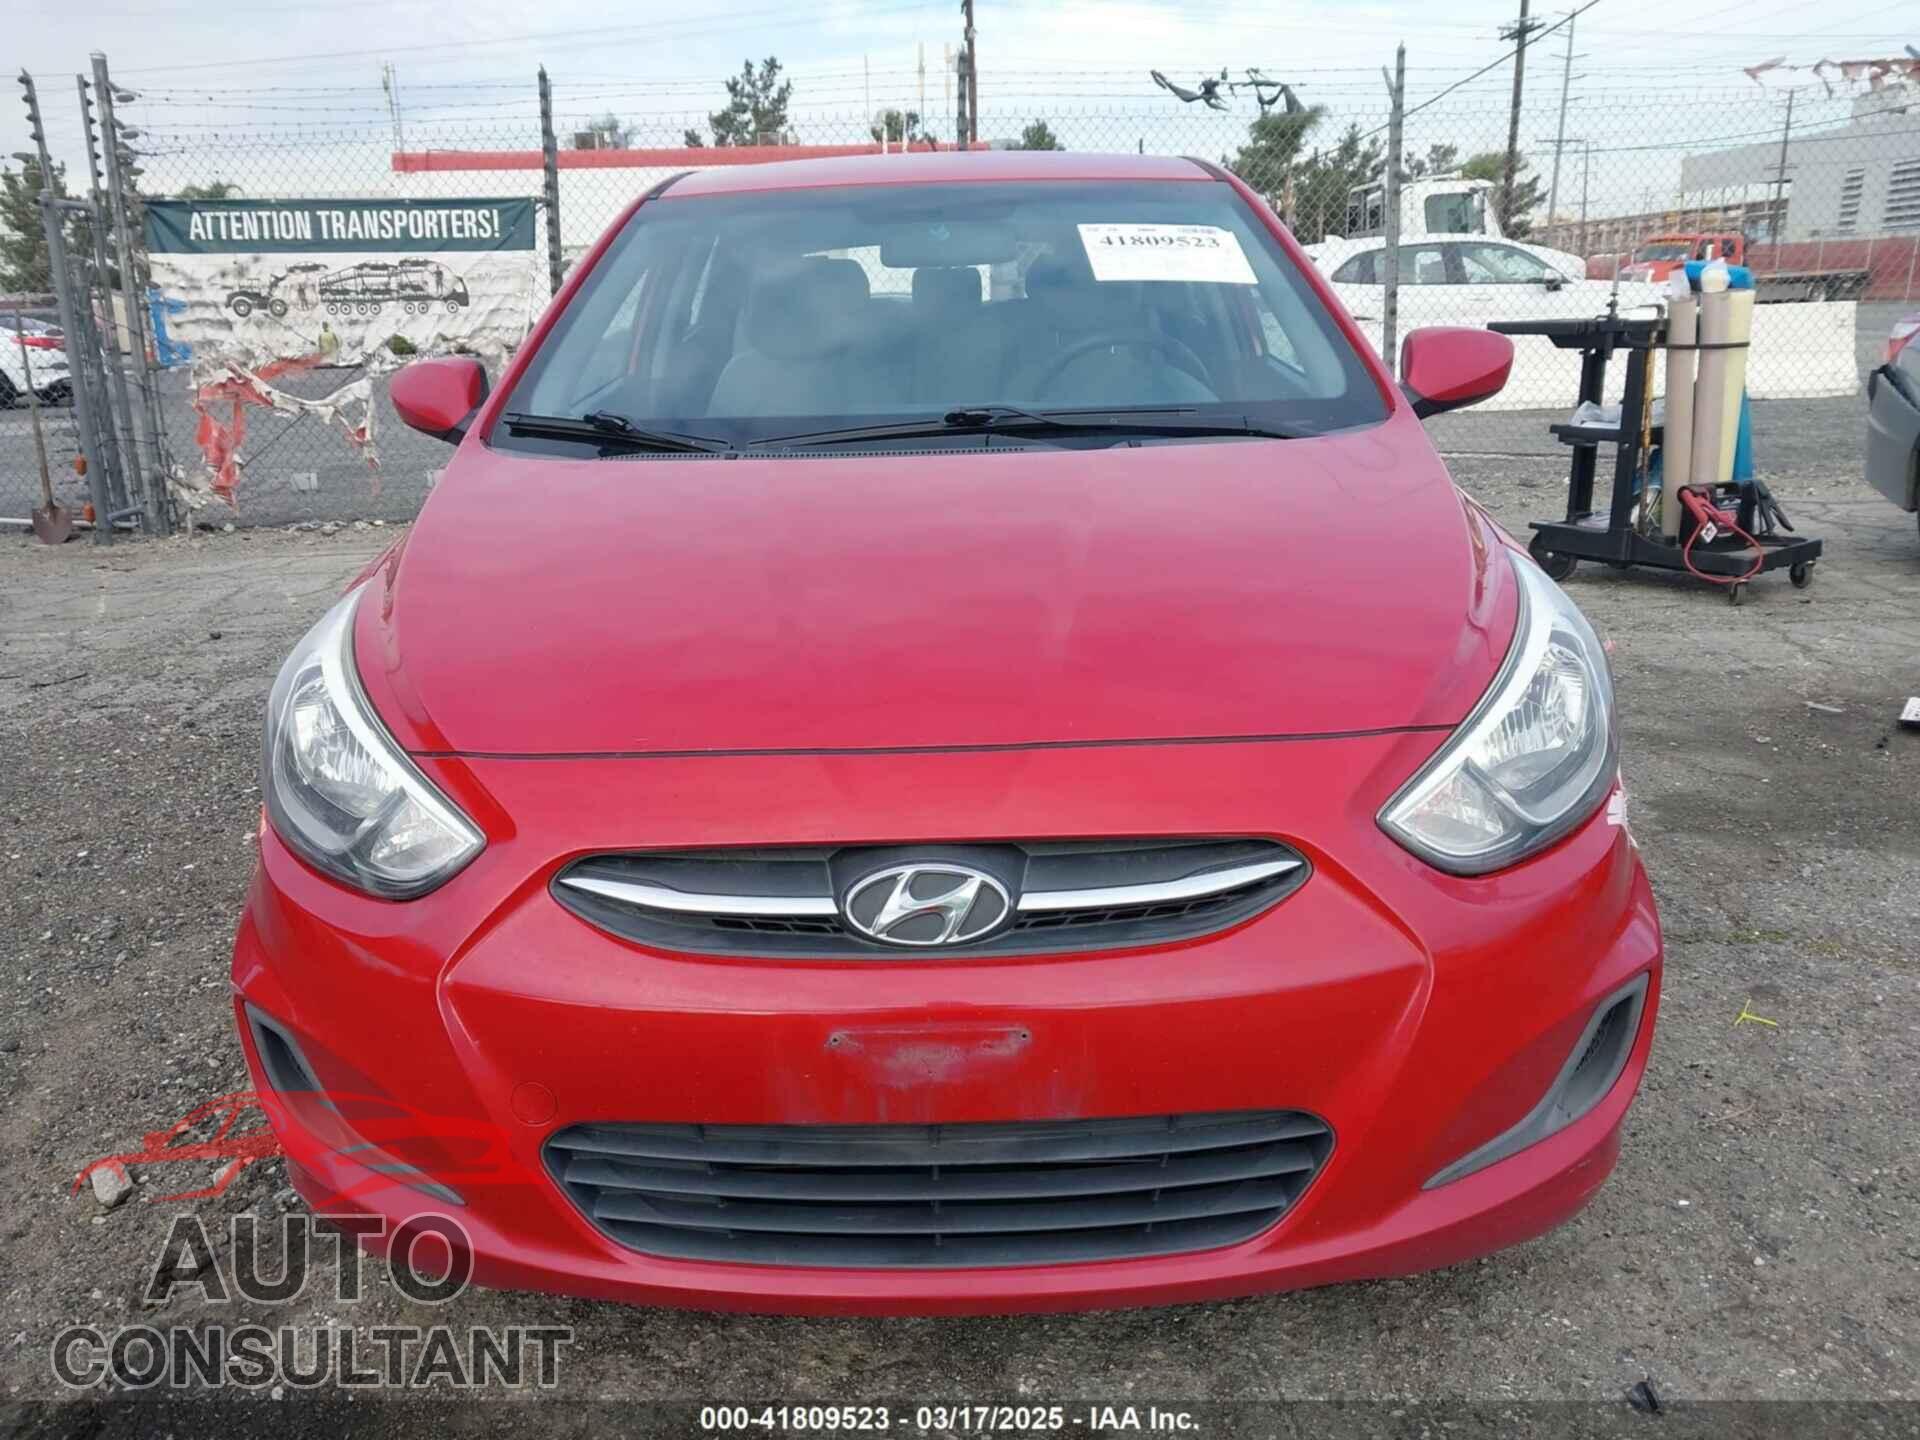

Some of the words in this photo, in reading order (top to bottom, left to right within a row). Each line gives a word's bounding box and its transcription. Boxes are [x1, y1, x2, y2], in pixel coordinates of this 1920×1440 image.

[189, 210, 312, 241] ATTENTION
[316, 208, 501, 240] TRANSPORTERS!
[1099, 234, 1221, 249] 41809523
